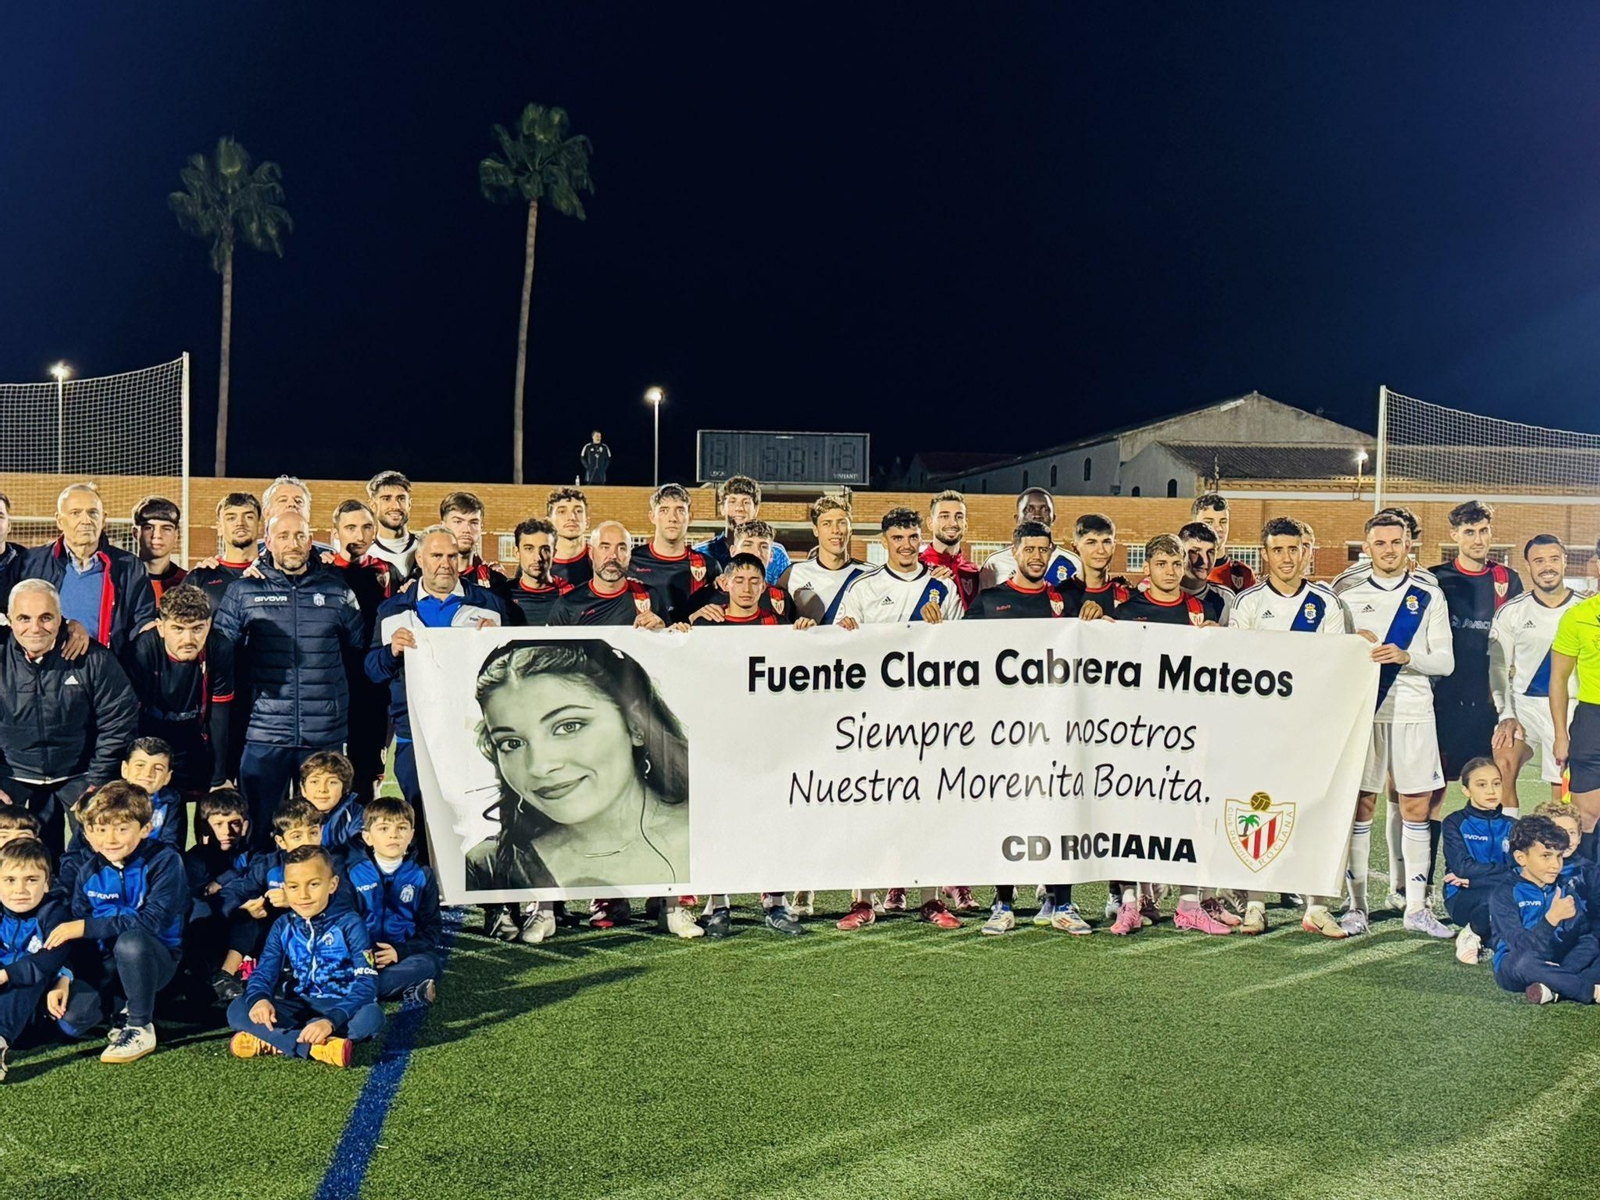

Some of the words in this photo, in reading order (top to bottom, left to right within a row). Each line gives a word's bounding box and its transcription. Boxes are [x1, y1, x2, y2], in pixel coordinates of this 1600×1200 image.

[748, 655, 867, 693] Fuente
[880, 650, 980, 690] Clara
[994, 648, 1142, 689] Cabrera
[1157, 653, 1294, 698] Mateos
[835, 711, 976, 762] Siempre
[990, 719, 1051, 746] con
[1065, 714, 1197, 751] nosotros
[789, 769, 921, 805] Nuestra
[937, 760, 1085, 801] Morenita
[1093, 763, 1210, 804] Bonita.
[1001, 835, 1052, 862] CD
[1060, 832, 1197, 864] ROCIANA
[1258, 810, 1293, 867] ROCIANA
